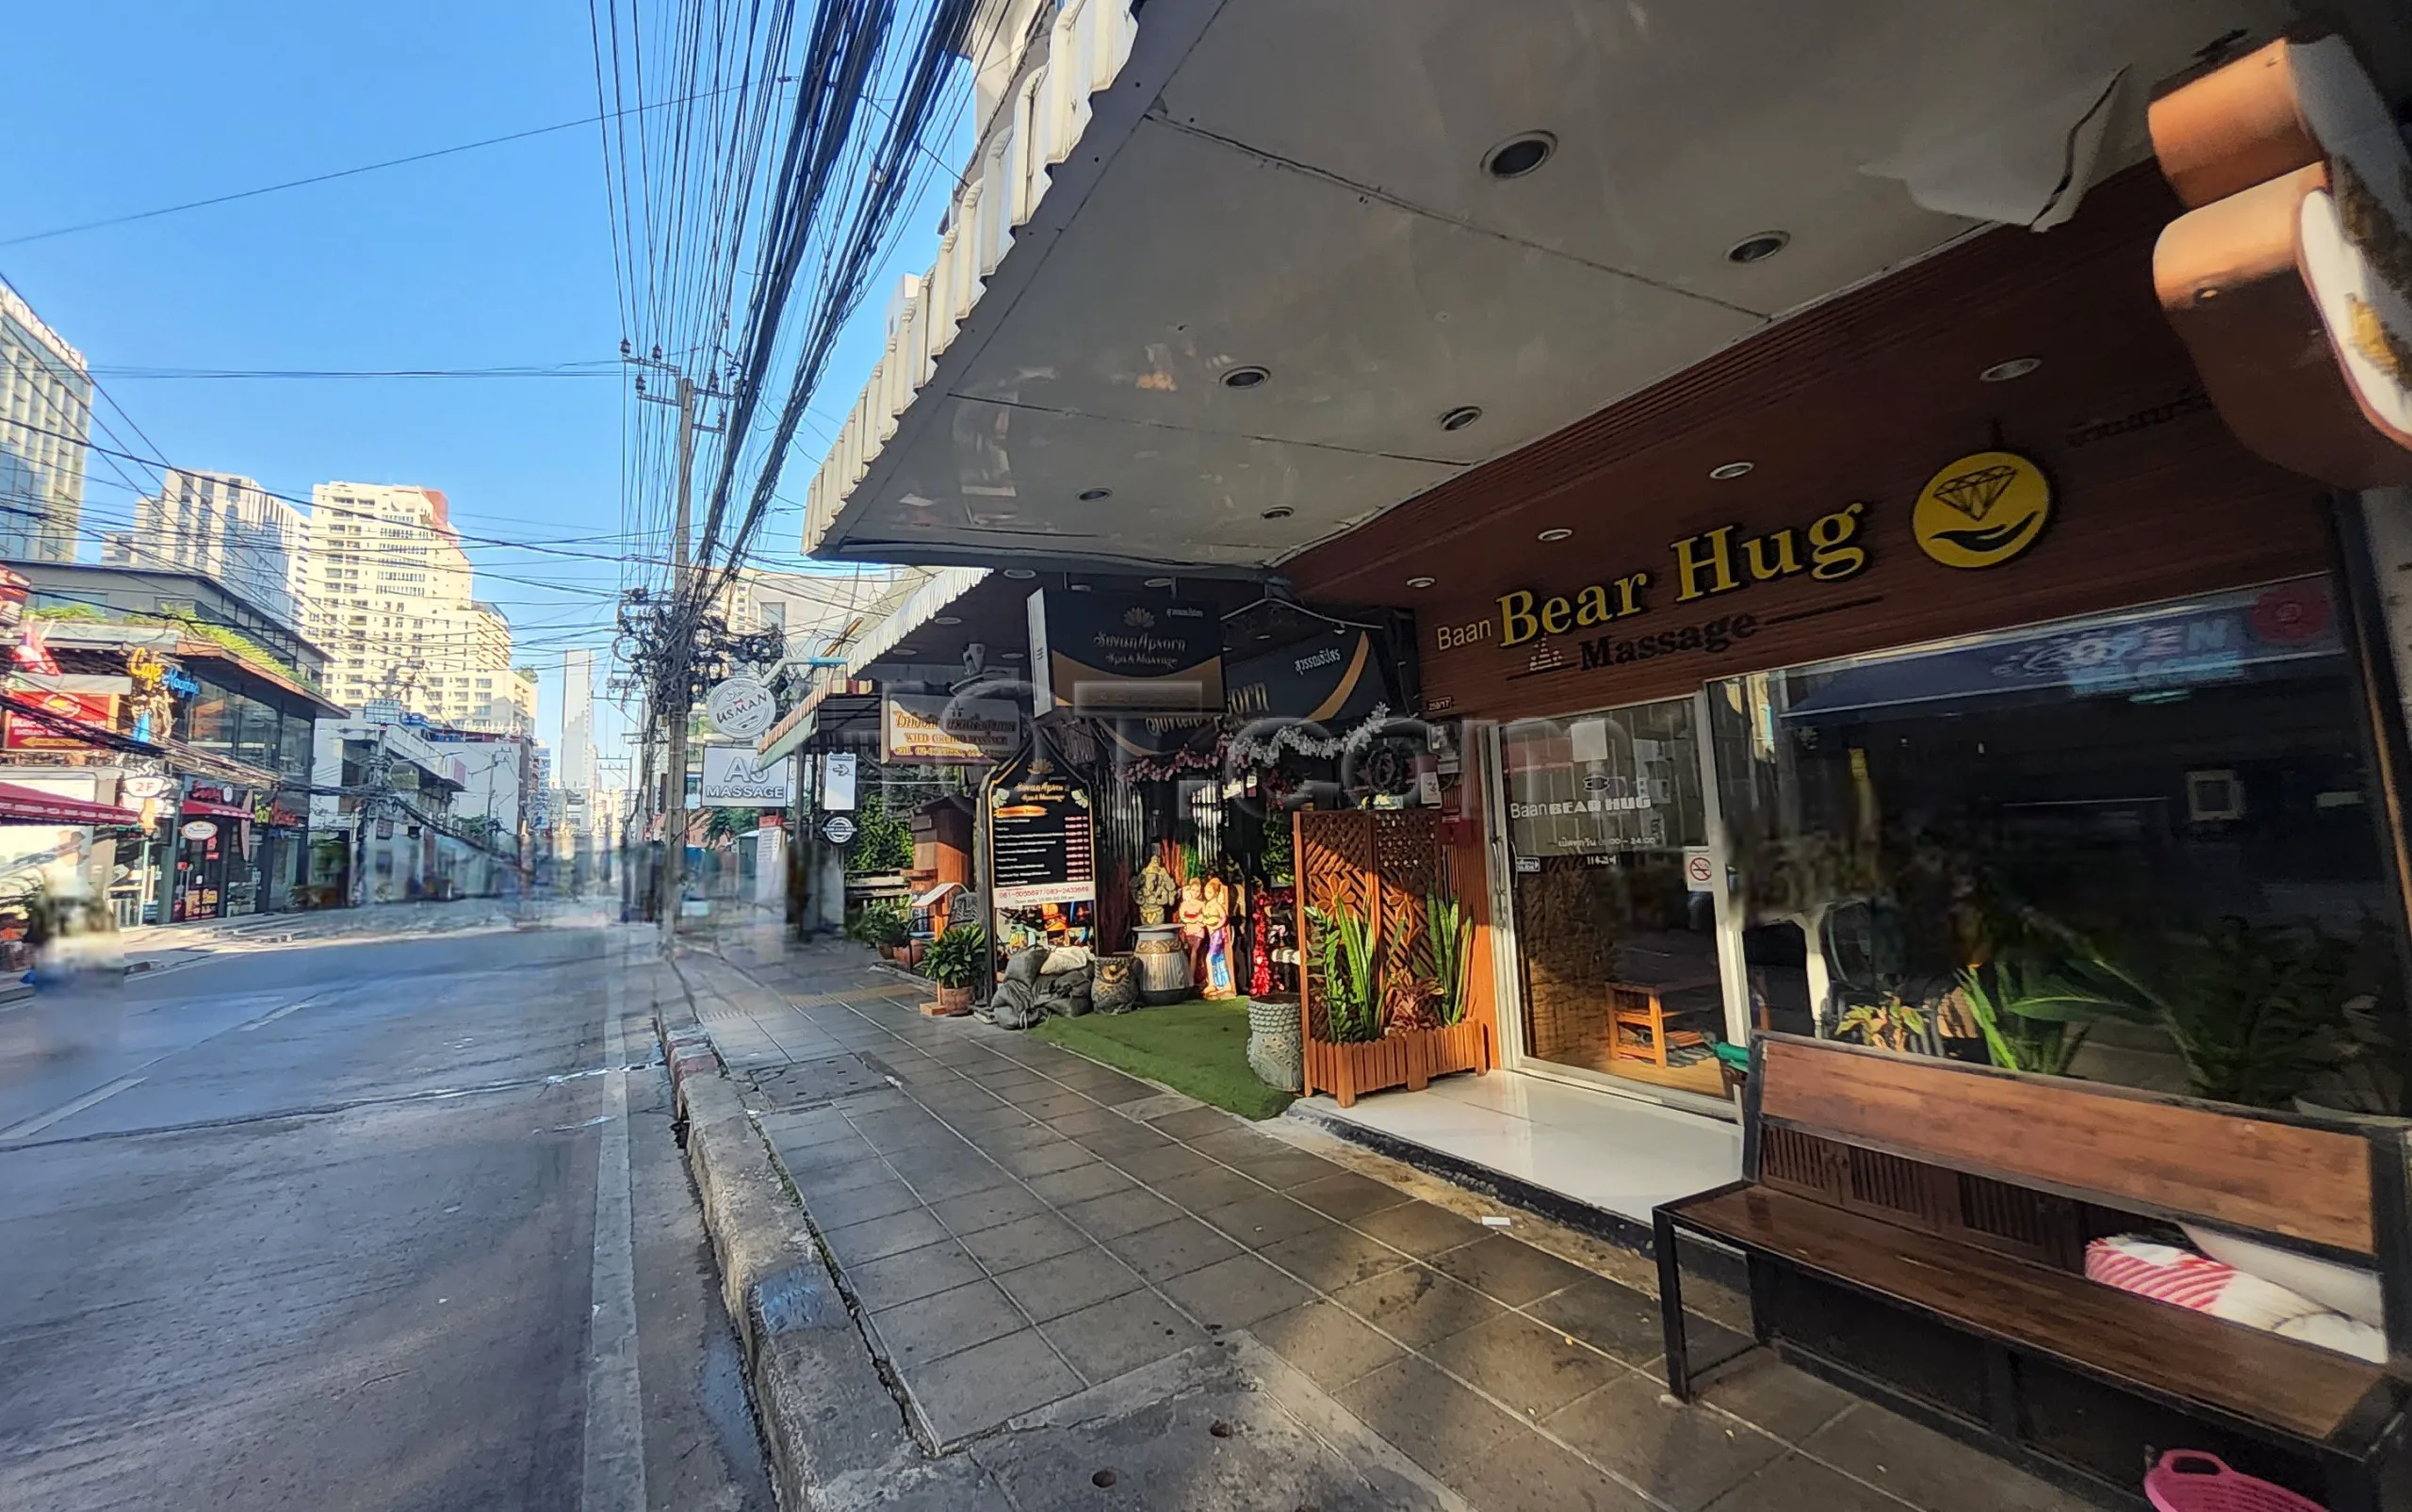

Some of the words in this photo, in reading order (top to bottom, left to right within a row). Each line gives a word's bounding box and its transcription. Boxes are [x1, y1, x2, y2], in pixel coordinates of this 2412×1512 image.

[1437, 619, 1491, 651] Baan
[1495, 573, 1648, 648] Bear
[1670, 502, 1865, 602] Hug
[1579, 612, 1758, 671] Massage
[715, 691, 768, 724] USMAN
[136, 782, 155, 792] 2F
[706, 786, 785, 799] MASSAGE
[1509, 802, 1547, 819] Baan
[1605, 796, 1652, 811] HUG
